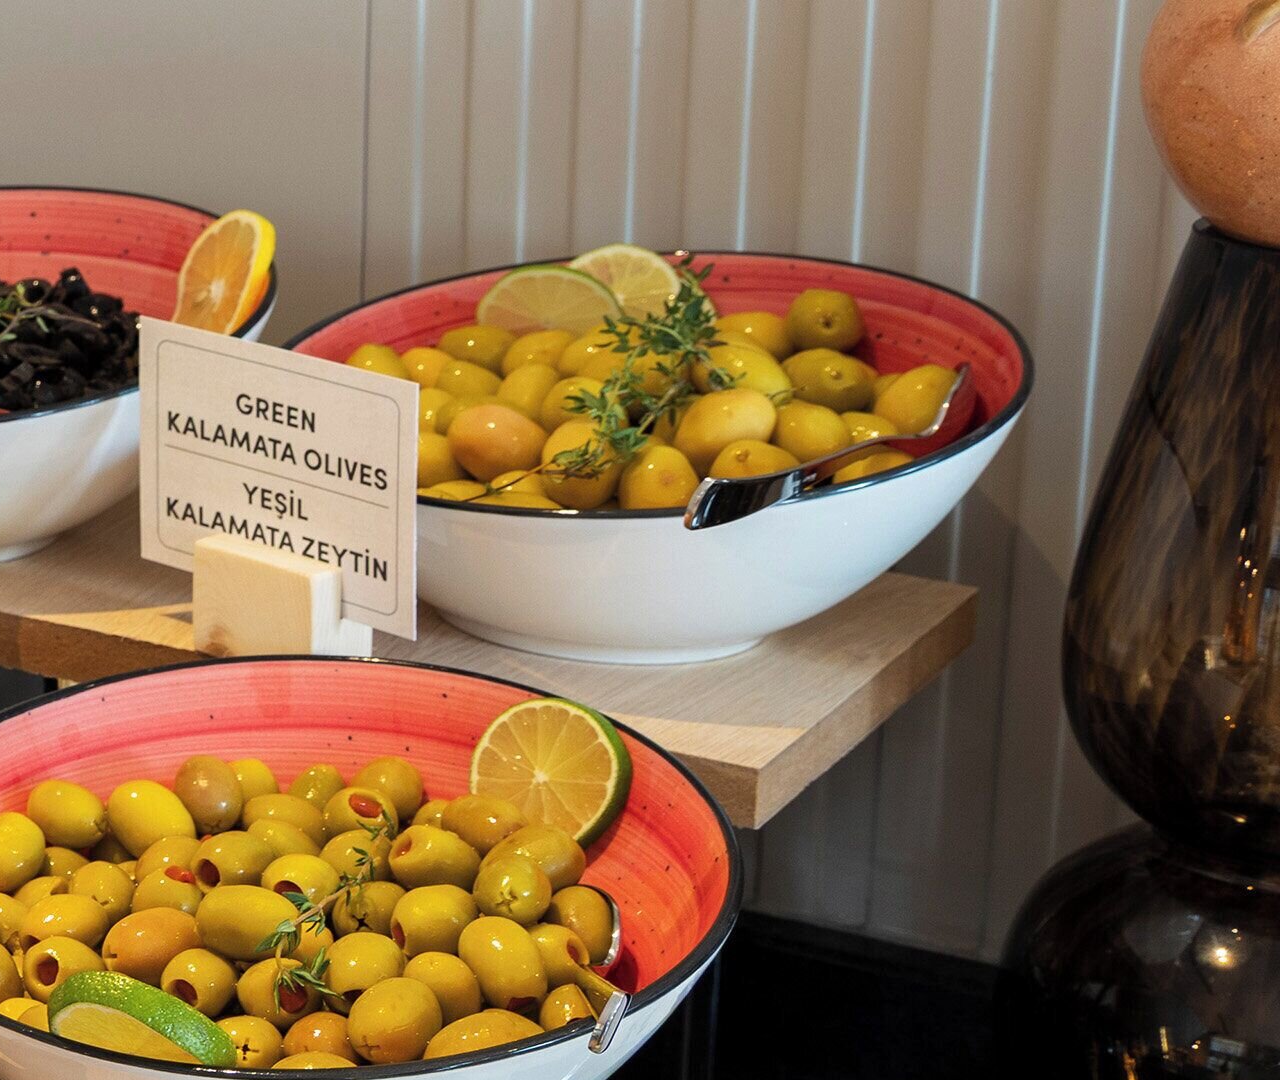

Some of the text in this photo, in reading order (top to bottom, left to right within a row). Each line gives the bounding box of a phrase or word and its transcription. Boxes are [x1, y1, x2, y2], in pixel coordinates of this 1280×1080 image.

[236, 393, 316, 433] GREEN
[167, 411, 388, 490] KALAMATA OLIVES
[243, 482, 309, 521] YEŞİL
[166, 497, 388, 582] KALAMATA ZEYTİN
